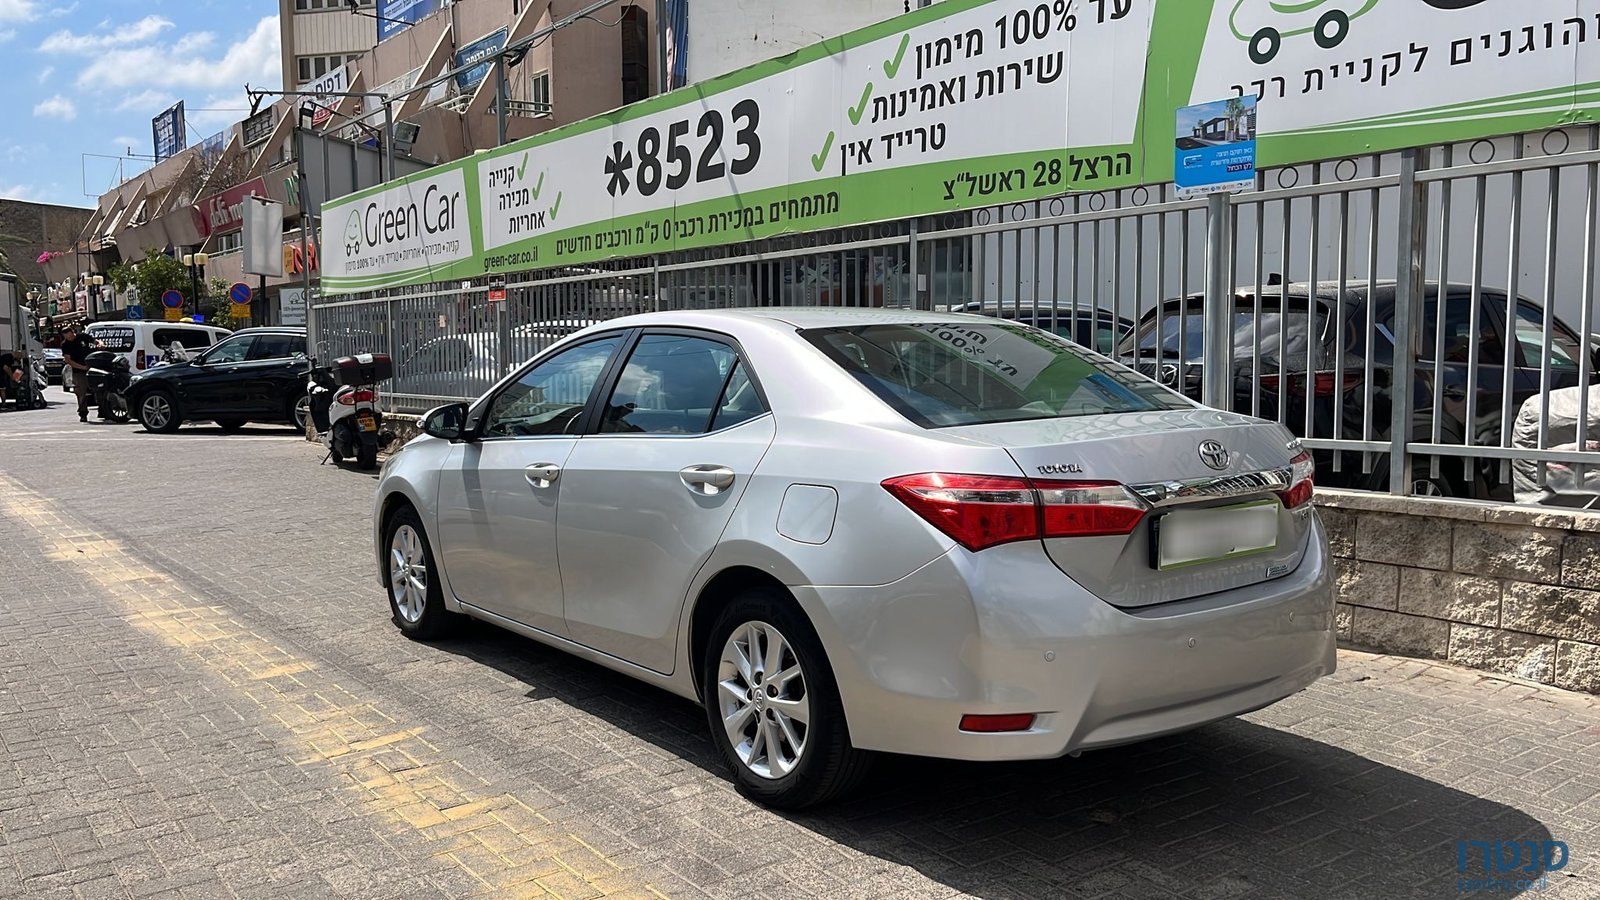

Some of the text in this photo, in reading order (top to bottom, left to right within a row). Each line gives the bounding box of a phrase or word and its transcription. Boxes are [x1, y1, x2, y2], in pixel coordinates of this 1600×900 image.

[916, 0, 1132, 79] עד 100% מימון
[1302, 42, 1428, 94] לקניית
[872, 51, 1064, 124] שירות ואמינות
[840, 122, 946, 176] טרייד אין
[488, 166, 515, 188] קנייה
[1032, 158, 1062, 187] 28
[1069, 151, 1132, 182] הרצל
[499, 188, 529, 211] מכירה
[769, 191, 840, 223] מתמחים
[365, 184, 459, 247] Green Car
[509, 211, 545, 234] אחריות
[663, 218, 671, 241] 0
[674, 215, 704, 239] רכבי
[708, 206, 764, 235] במכירת
[556, 229, 592, 256] חדשים
[594, 224, 632, 250] ורכבים
[484, 246, 538, 272] green-car.co.il
[1037, 463, 1083, 474] TOYOTA
